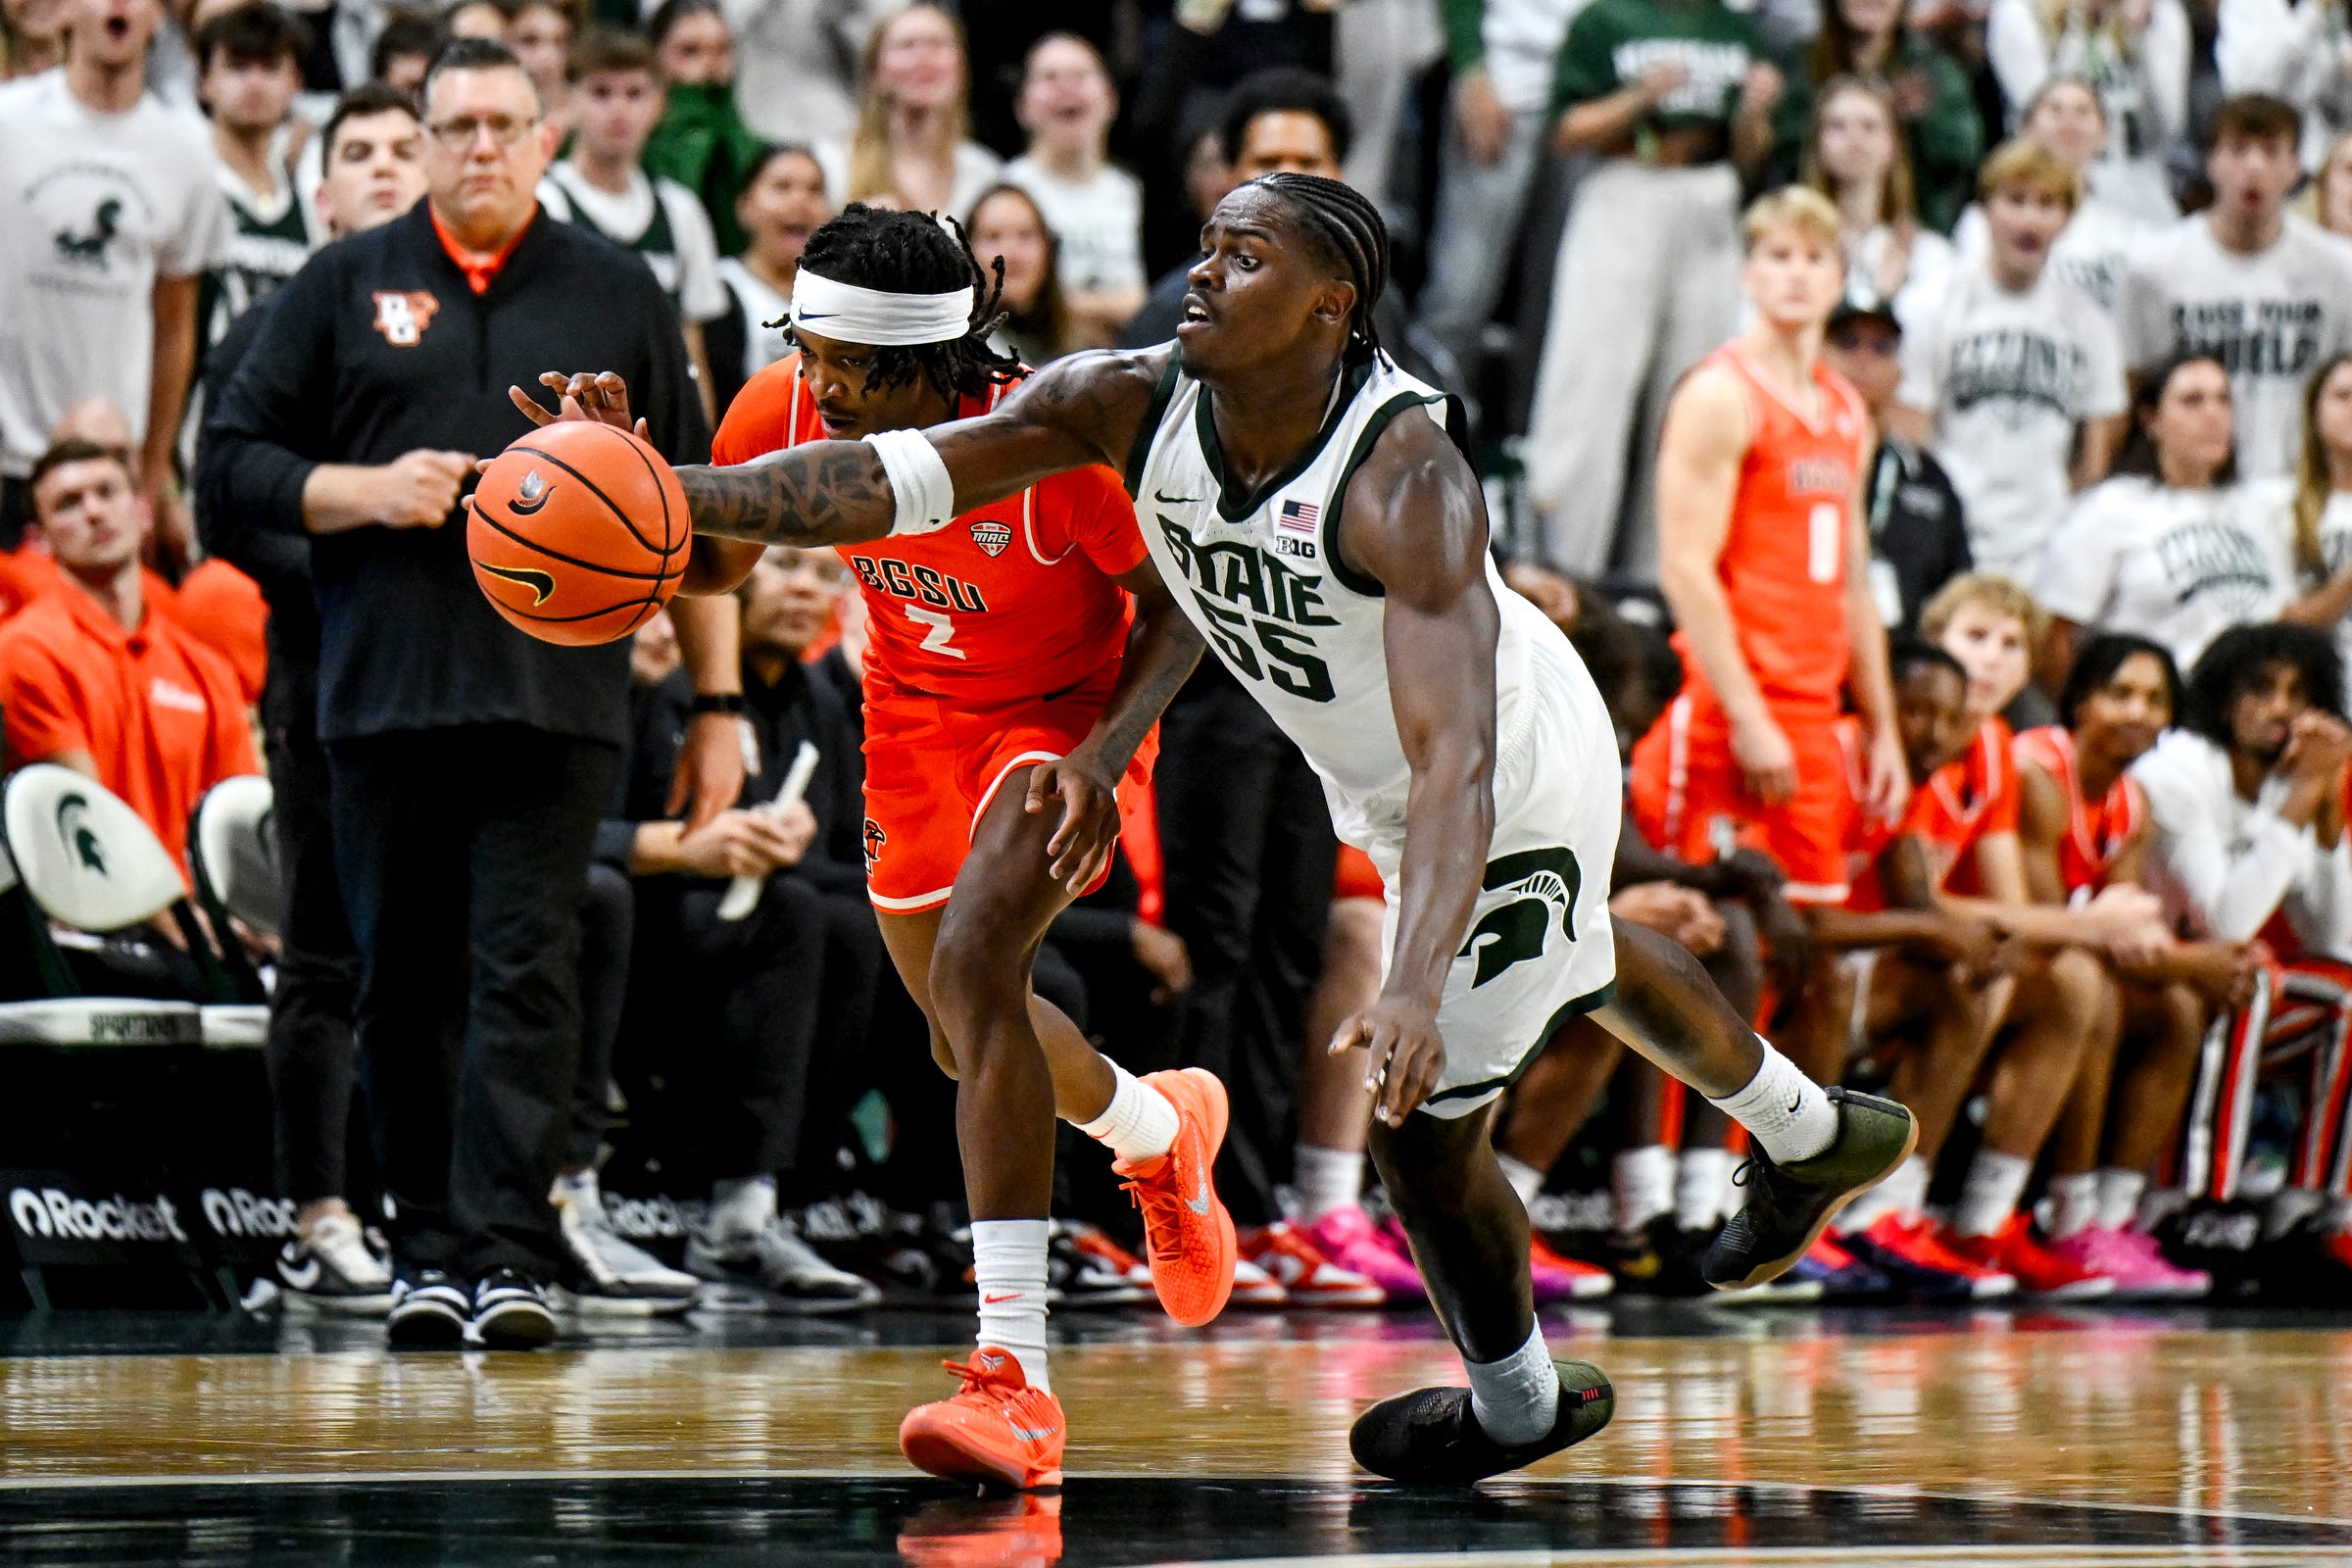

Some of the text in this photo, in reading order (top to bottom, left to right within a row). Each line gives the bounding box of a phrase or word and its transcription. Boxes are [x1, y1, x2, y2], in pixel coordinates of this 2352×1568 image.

[973, 532, 1009, 544] MAC
[850, 556, 989, 612] BGSU
[1155, 513, 1342, 626] STATE
[905, 603, 966, 661] 2
[1190, 587, 1336, 703] 55
[228, 1187, 298, 1238] Roc
